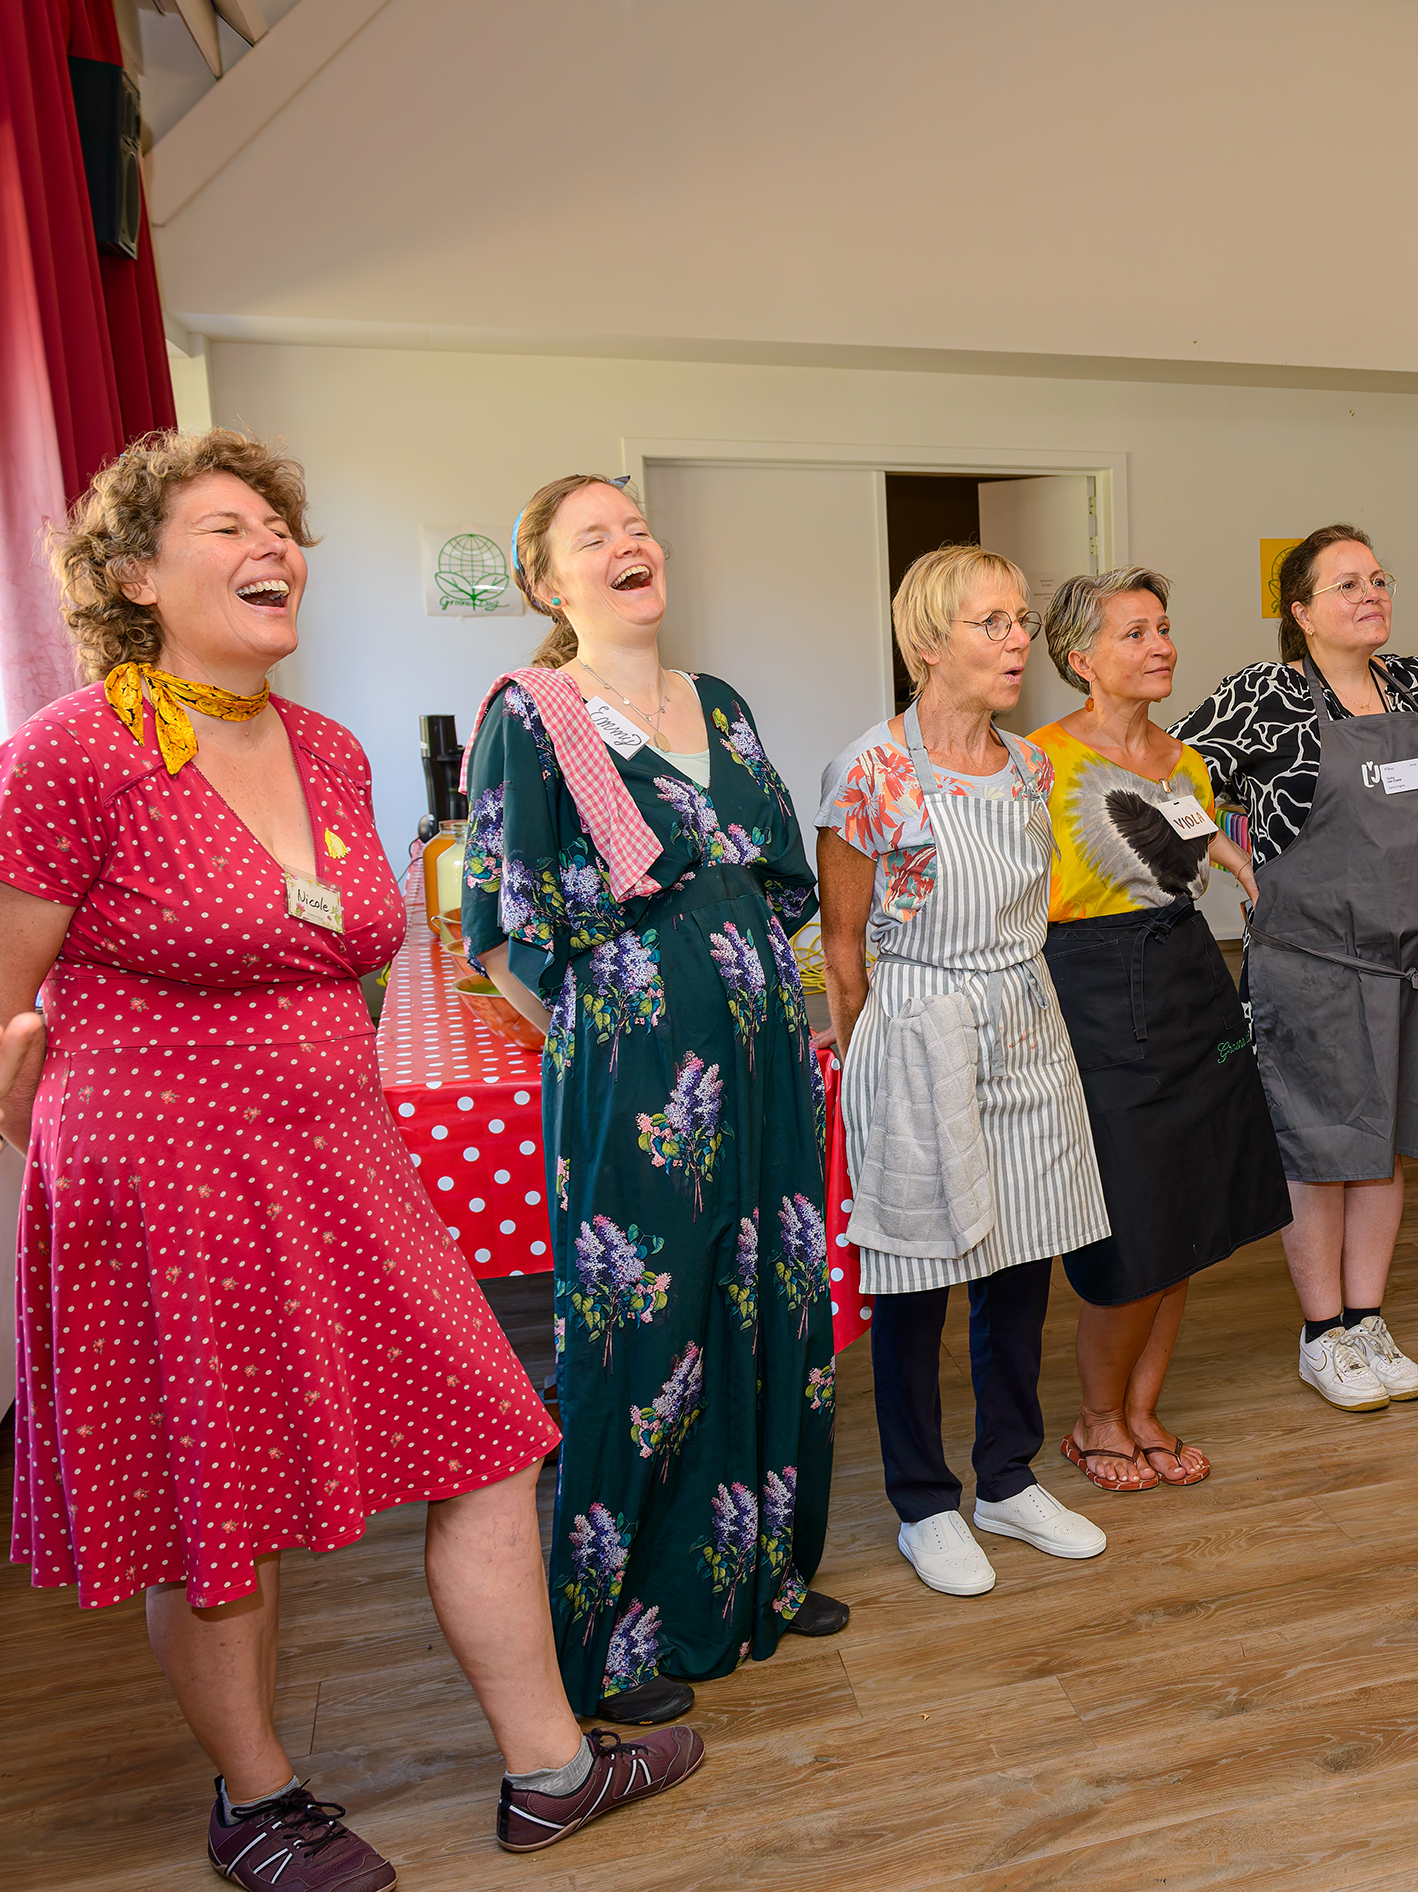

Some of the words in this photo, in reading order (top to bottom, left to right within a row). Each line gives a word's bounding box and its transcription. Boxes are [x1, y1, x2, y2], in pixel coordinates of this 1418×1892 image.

[590, 705, 642, 746] Emmy
[1173, 811, 1205, 830] VIOLA
[297, 888, 329, 912] Nicole
